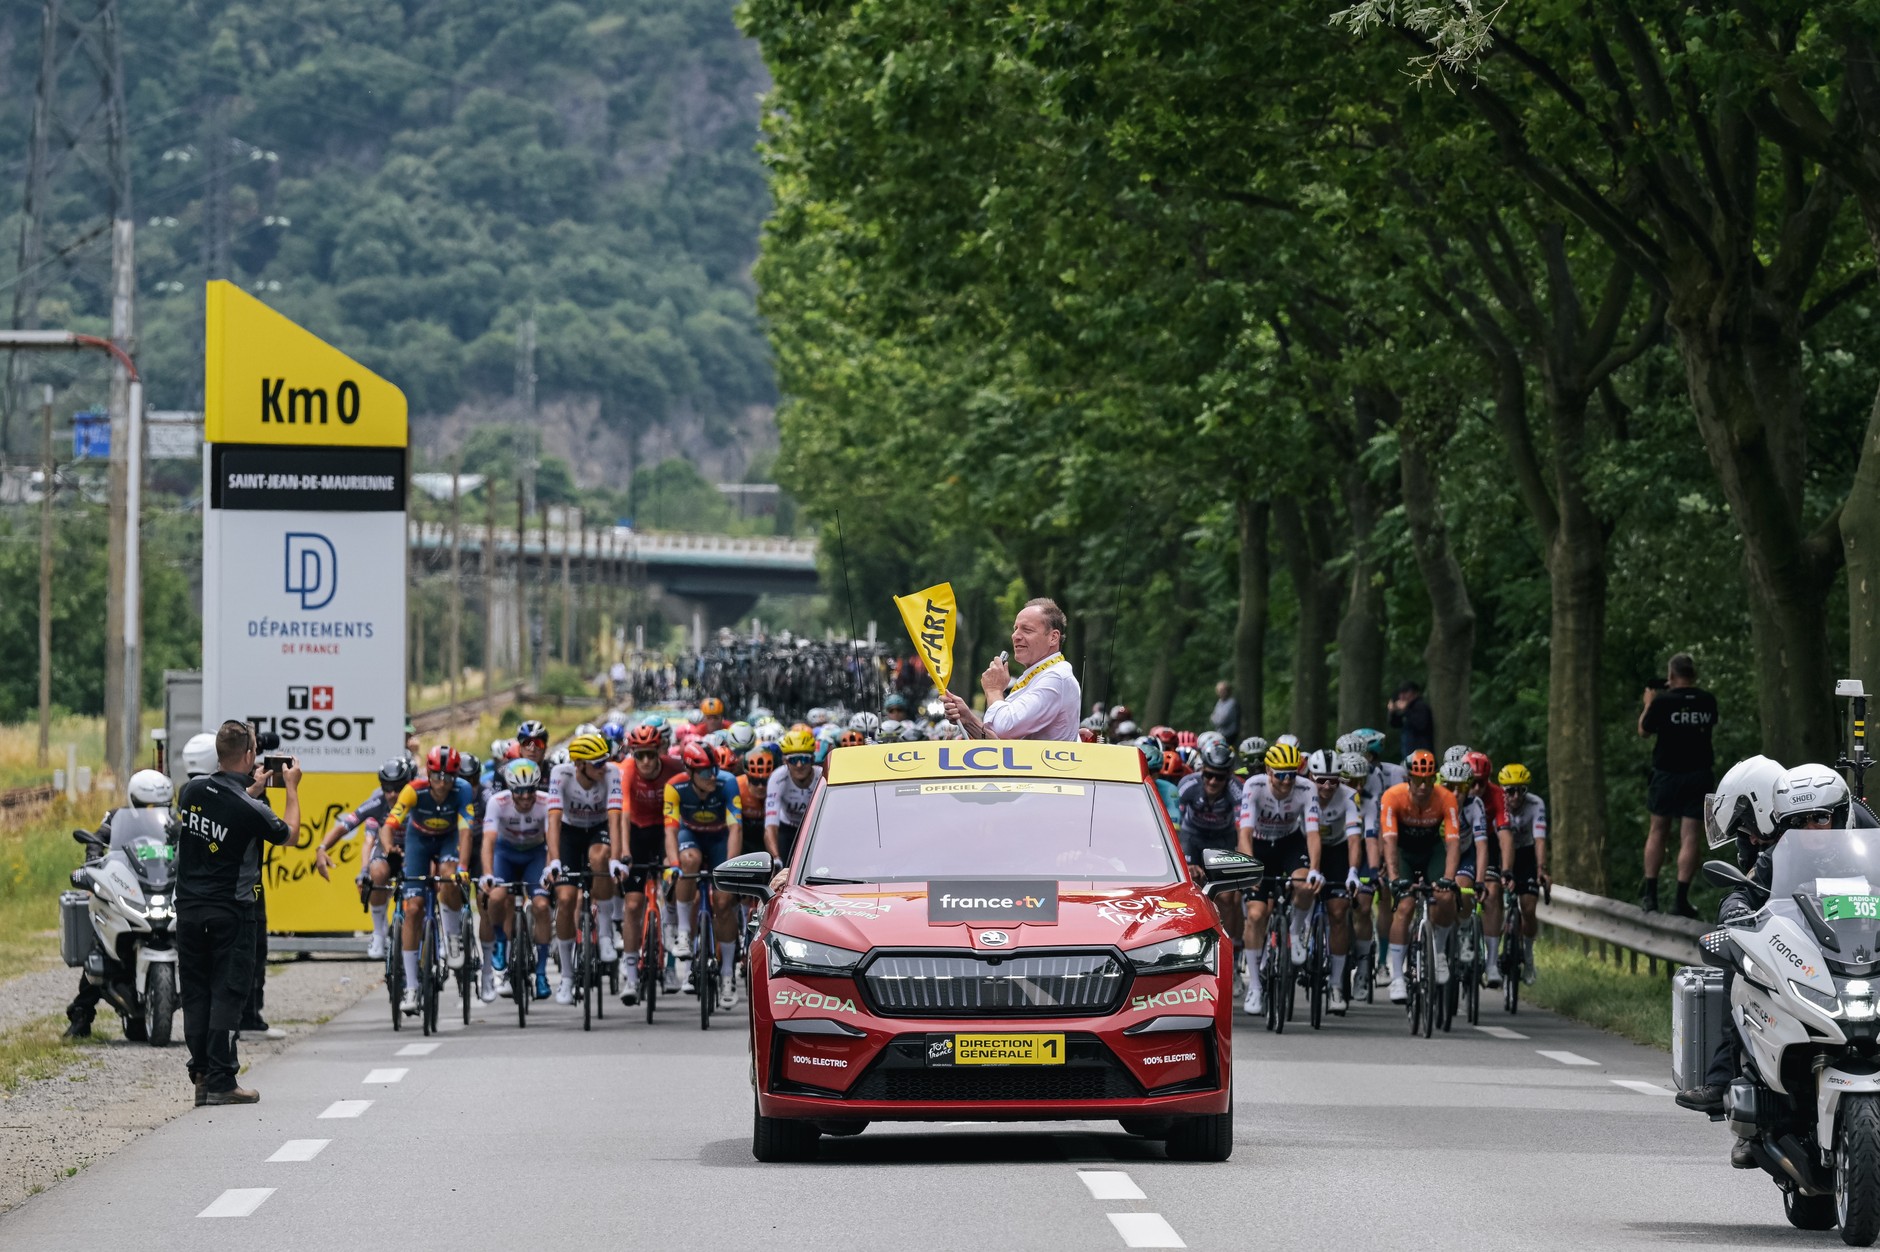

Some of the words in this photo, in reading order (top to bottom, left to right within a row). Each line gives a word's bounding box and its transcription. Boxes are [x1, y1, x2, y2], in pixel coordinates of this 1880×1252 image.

[261, 378, 328, 423] Km
[337, 380, 360, 424] 0
[228, 473, 395, 491] SAINT-JEAN-DE-MAURIENNE
[248, 616, 374, 638] DÉPARTEMENTS
[282, 643, 294, 654] DE
[300, 643, 340, 655] FRANCE
[1671, 711, 1711, 724] CREW
[247, 716, 374, 741] TISSOT
[888, 750, 925, 763] LCL
[938, 747, 1032, 770] LCL
[1045, 750, 1082, 762] LCL
[925, 784, 978, 792] OFFICIEL
[1792, 793, 1813, 804] SHOEI
[181, 809, 229, 842] CREW
[1848, 896, 1880, 904] RADIO-TV
[1853, 902, 1877, 917] 305
[960, 1039, 1033, 1048] DIRECTION
[1042, 1039, 1057, 1058] 1
[960, 1048, 1033, 1058] GÉNÉRALE
[793, 1055, 811, 1065] 100%
[812, 1057, 848, 1068] ELECTRIC
[1143, 1055, 1163, 1065] 100%
[1164, 1053, 1197, 1063] ELECTRIC
